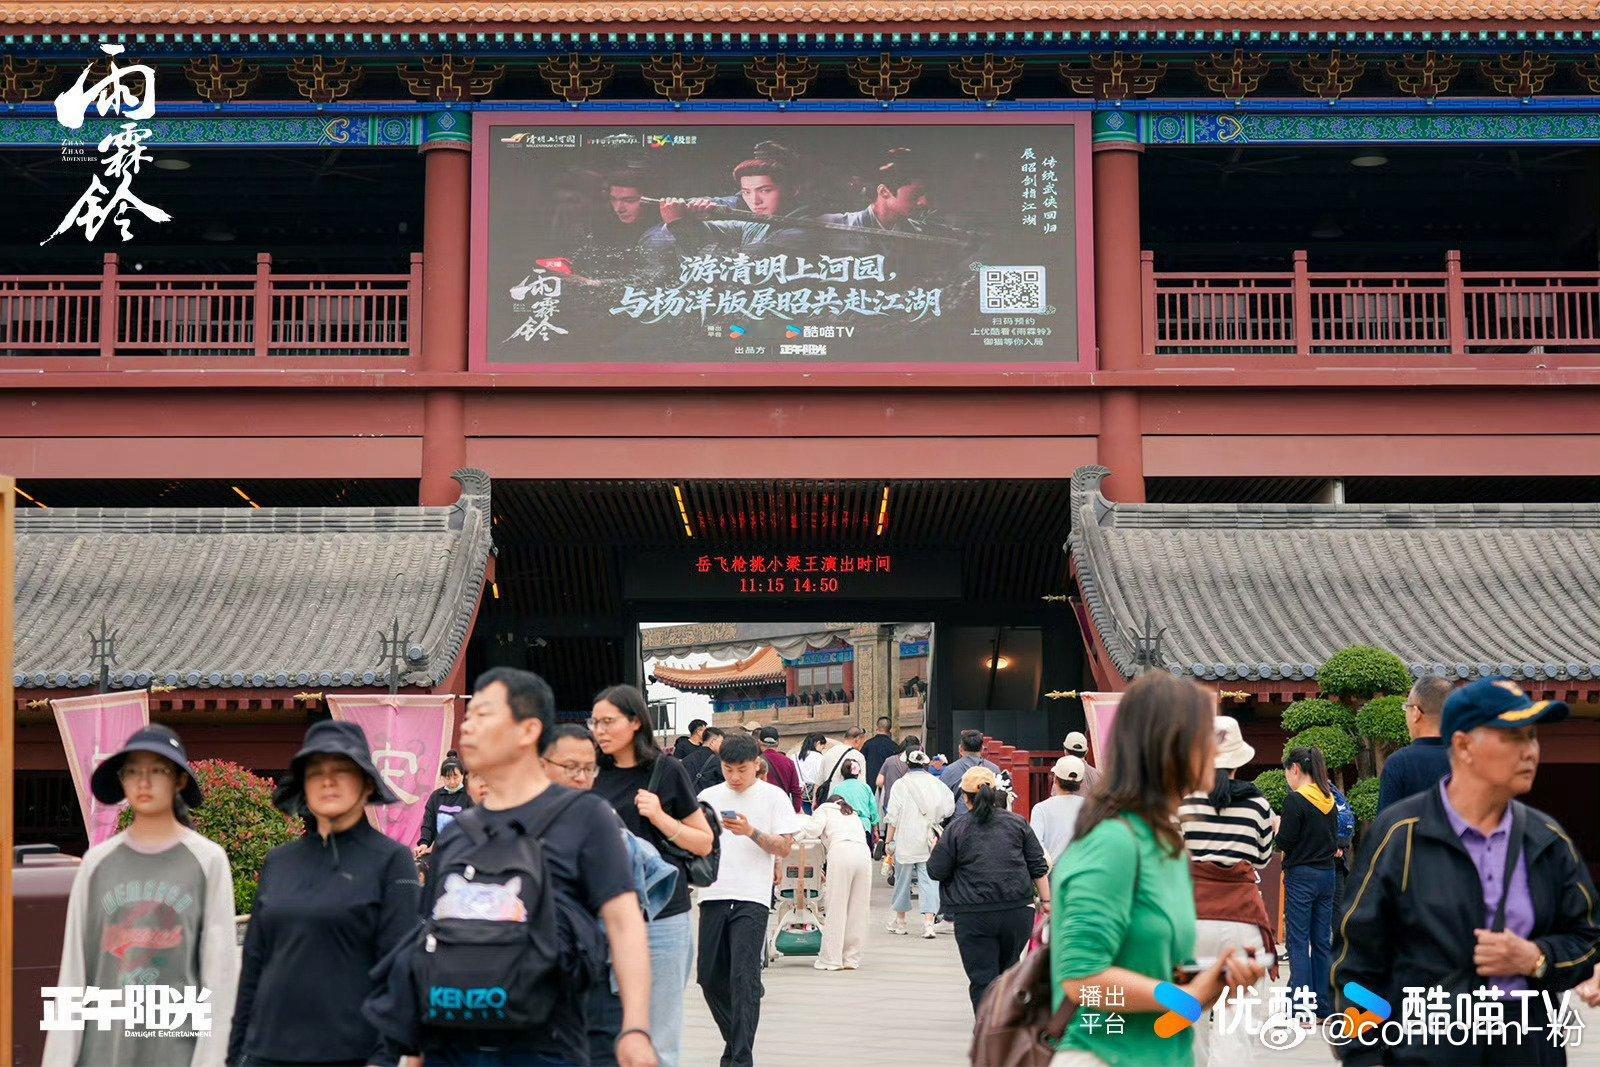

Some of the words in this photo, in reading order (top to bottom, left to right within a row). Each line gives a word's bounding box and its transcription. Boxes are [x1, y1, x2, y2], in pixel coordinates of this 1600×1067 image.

[1021, 147, 1037, 226] 展昭剑指江湖
[1042, 156, 1058, 234] 传统武侠回归
[608, 285, 944, 325] 与杨洋版展昭共赴江湖
[803, 325, 855, 338] 酷喵TV
[734, 346, 766, 355] 出品方
[695, 555, 892, 573] 岳飞枪挑小梁王演出时间
[740, 578, 785, 592] 11:15
[794, 578, 838, 592] 14:50
[428, 986, 508, 1009] KENZO
